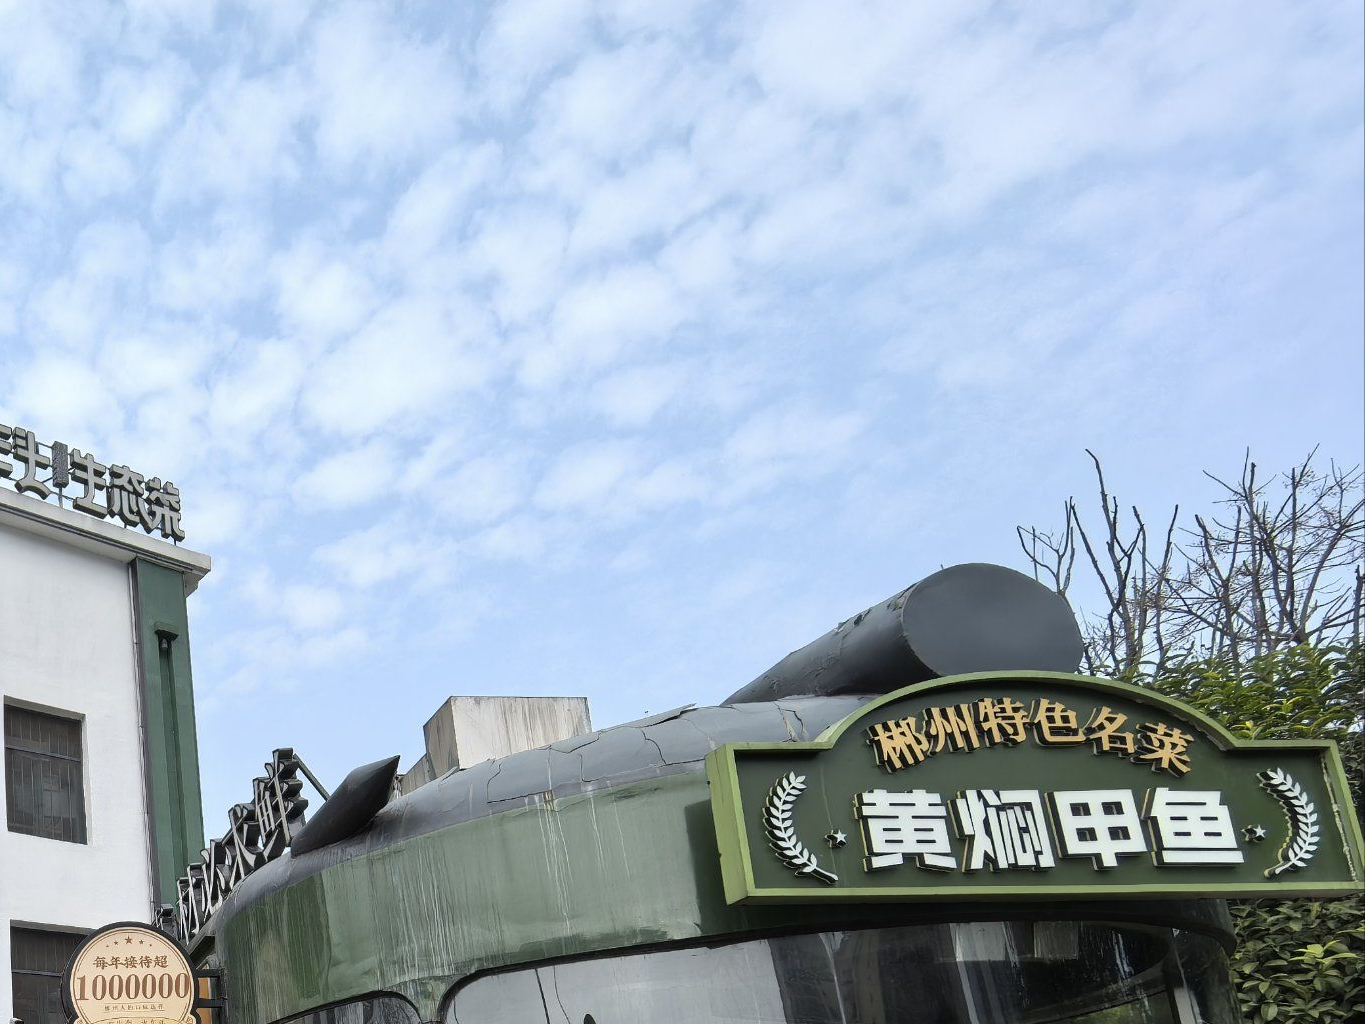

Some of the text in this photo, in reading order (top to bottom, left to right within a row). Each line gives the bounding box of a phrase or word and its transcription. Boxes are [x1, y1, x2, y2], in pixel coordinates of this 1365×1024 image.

[867, 697, 1194, 777] 郴州特色名菜
[854, 788, 1244, 872] 黄焖甲鱼
[75, 973, 190, 1000] 1000000
[93, 956, 169, 969] 每年接待超
